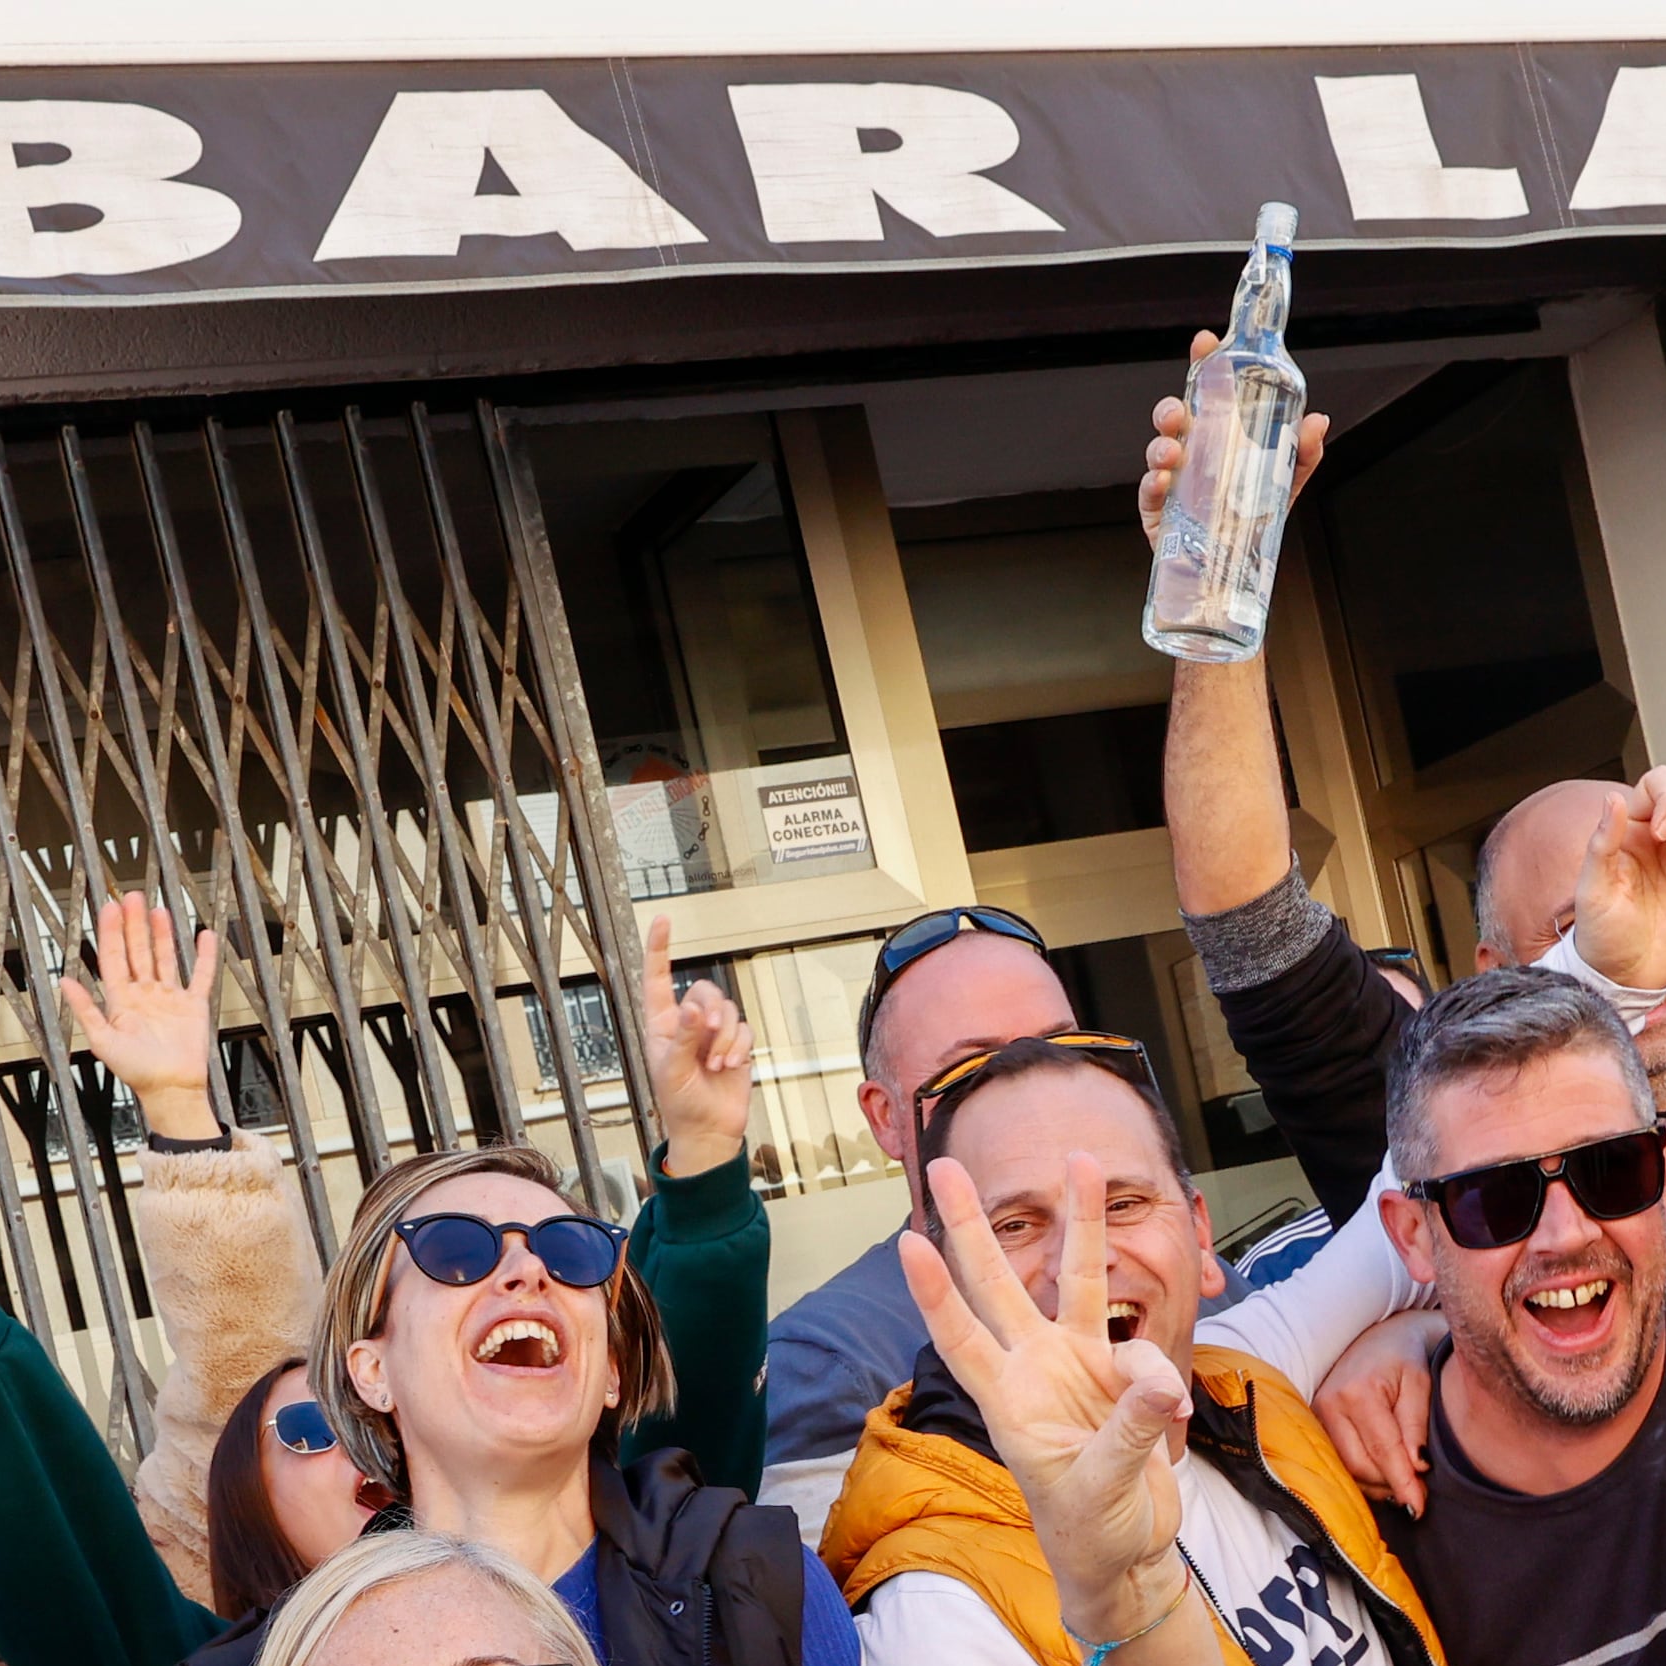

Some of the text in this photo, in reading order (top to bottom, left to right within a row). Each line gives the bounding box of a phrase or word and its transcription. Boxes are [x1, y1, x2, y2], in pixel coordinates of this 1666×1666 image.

[768, 783, 847, 804] ATENCIÓN!!!
[784, 808, 843, 826] ALARMA
[773, 821, 860, 841] CONECTADA
